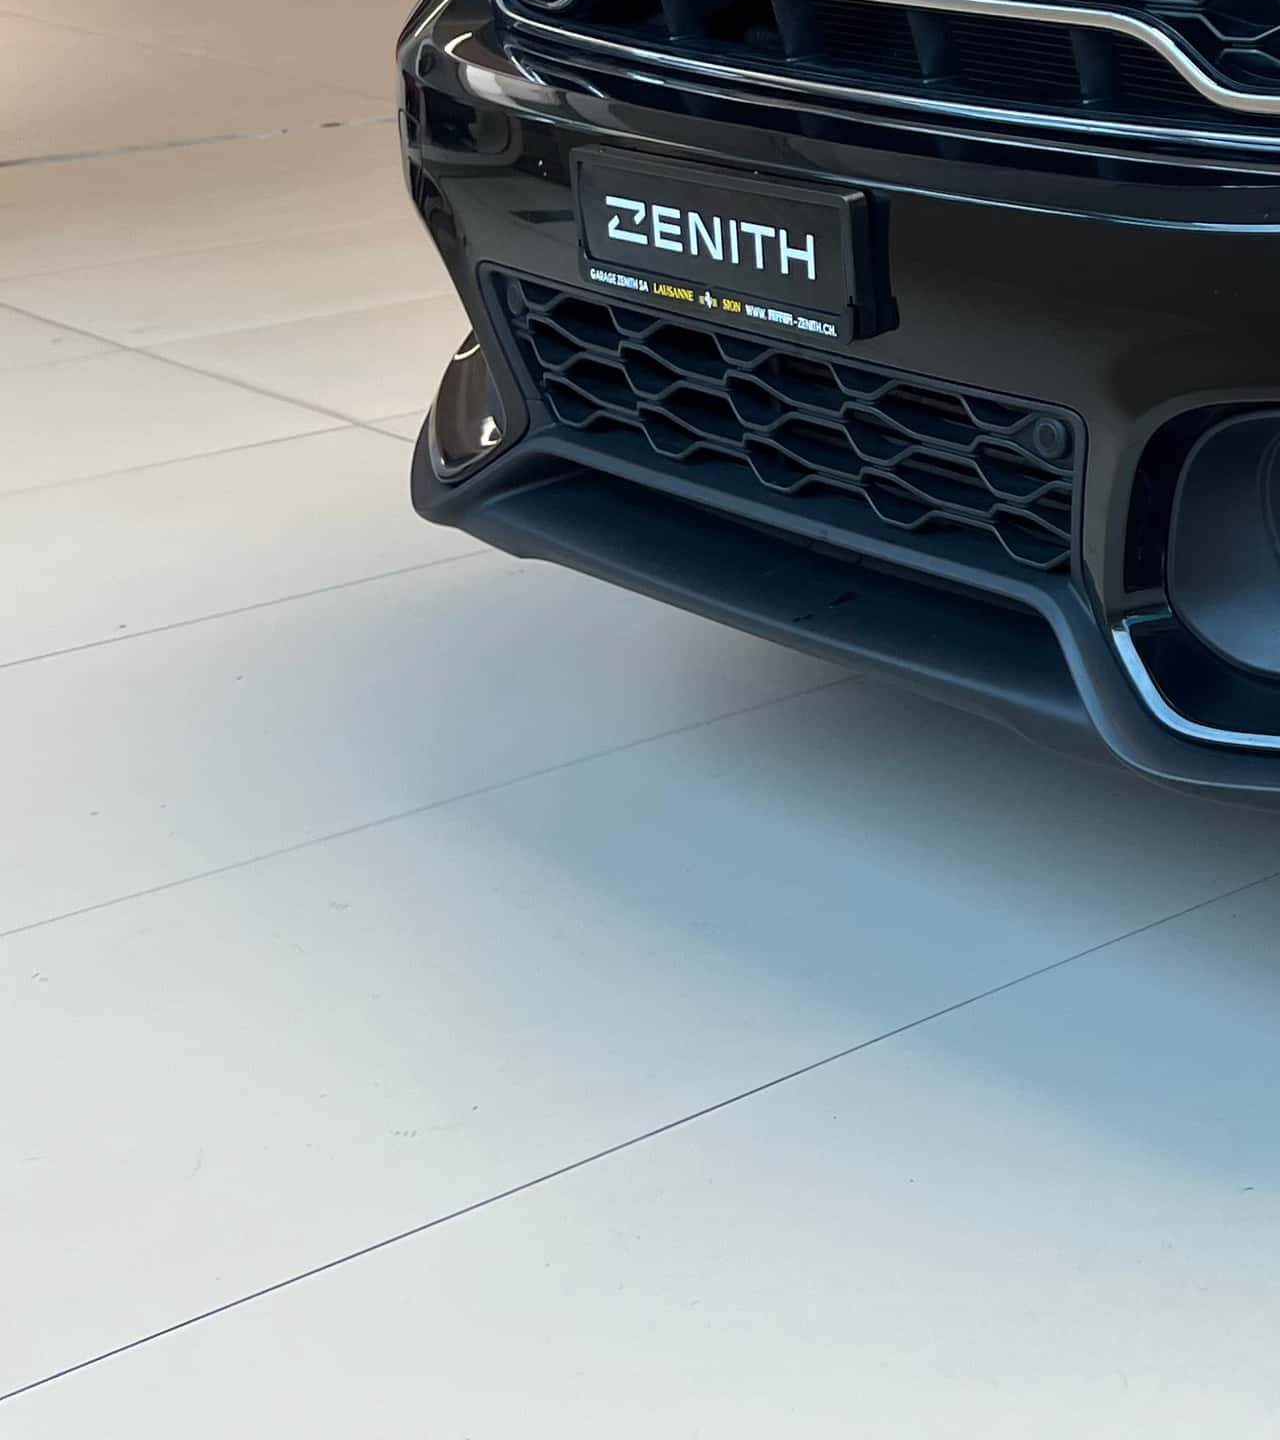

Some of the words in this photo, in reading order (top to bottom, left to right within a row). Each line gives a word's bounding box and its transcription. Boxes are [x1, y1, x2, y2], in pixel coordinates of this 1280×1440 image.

[605, 194, 817, 281] ZENITH
[653, 282, 695, 302] LAUSANNE
[722, 298, 741, 313] SION
